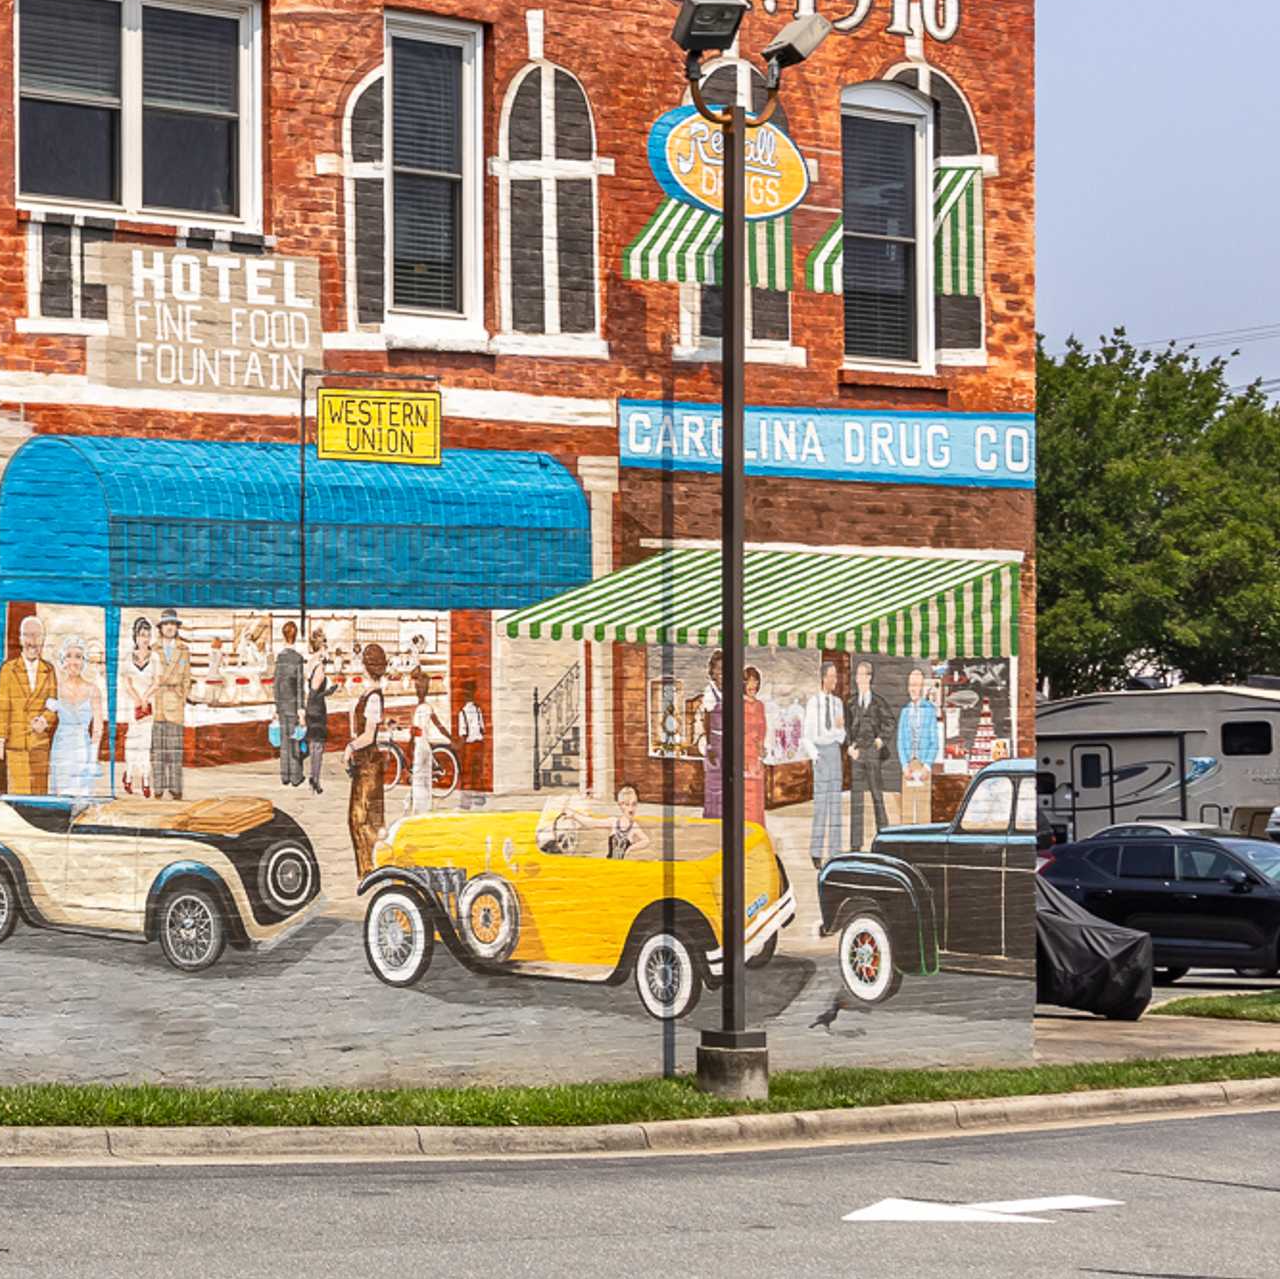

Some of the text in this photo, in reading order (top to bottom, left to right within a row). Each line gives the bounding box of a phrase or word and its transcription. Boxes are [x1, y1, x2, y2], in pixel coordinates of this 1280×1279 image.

[677, 122, 777, 175] Reall
[701, 166, 780, 208] DGS
[131, 249, 315, 308] HOTEL
[135, 301, 311, 350] FINE FOOD
[135, 341, 305, 391] FOUNTAIN
[327, 398, 429, 429] WESTERN
[346, 428, 415, 456] UNION
[843, 420, 951, 470] DRUG
[974, 424, 1032, 473] CO
